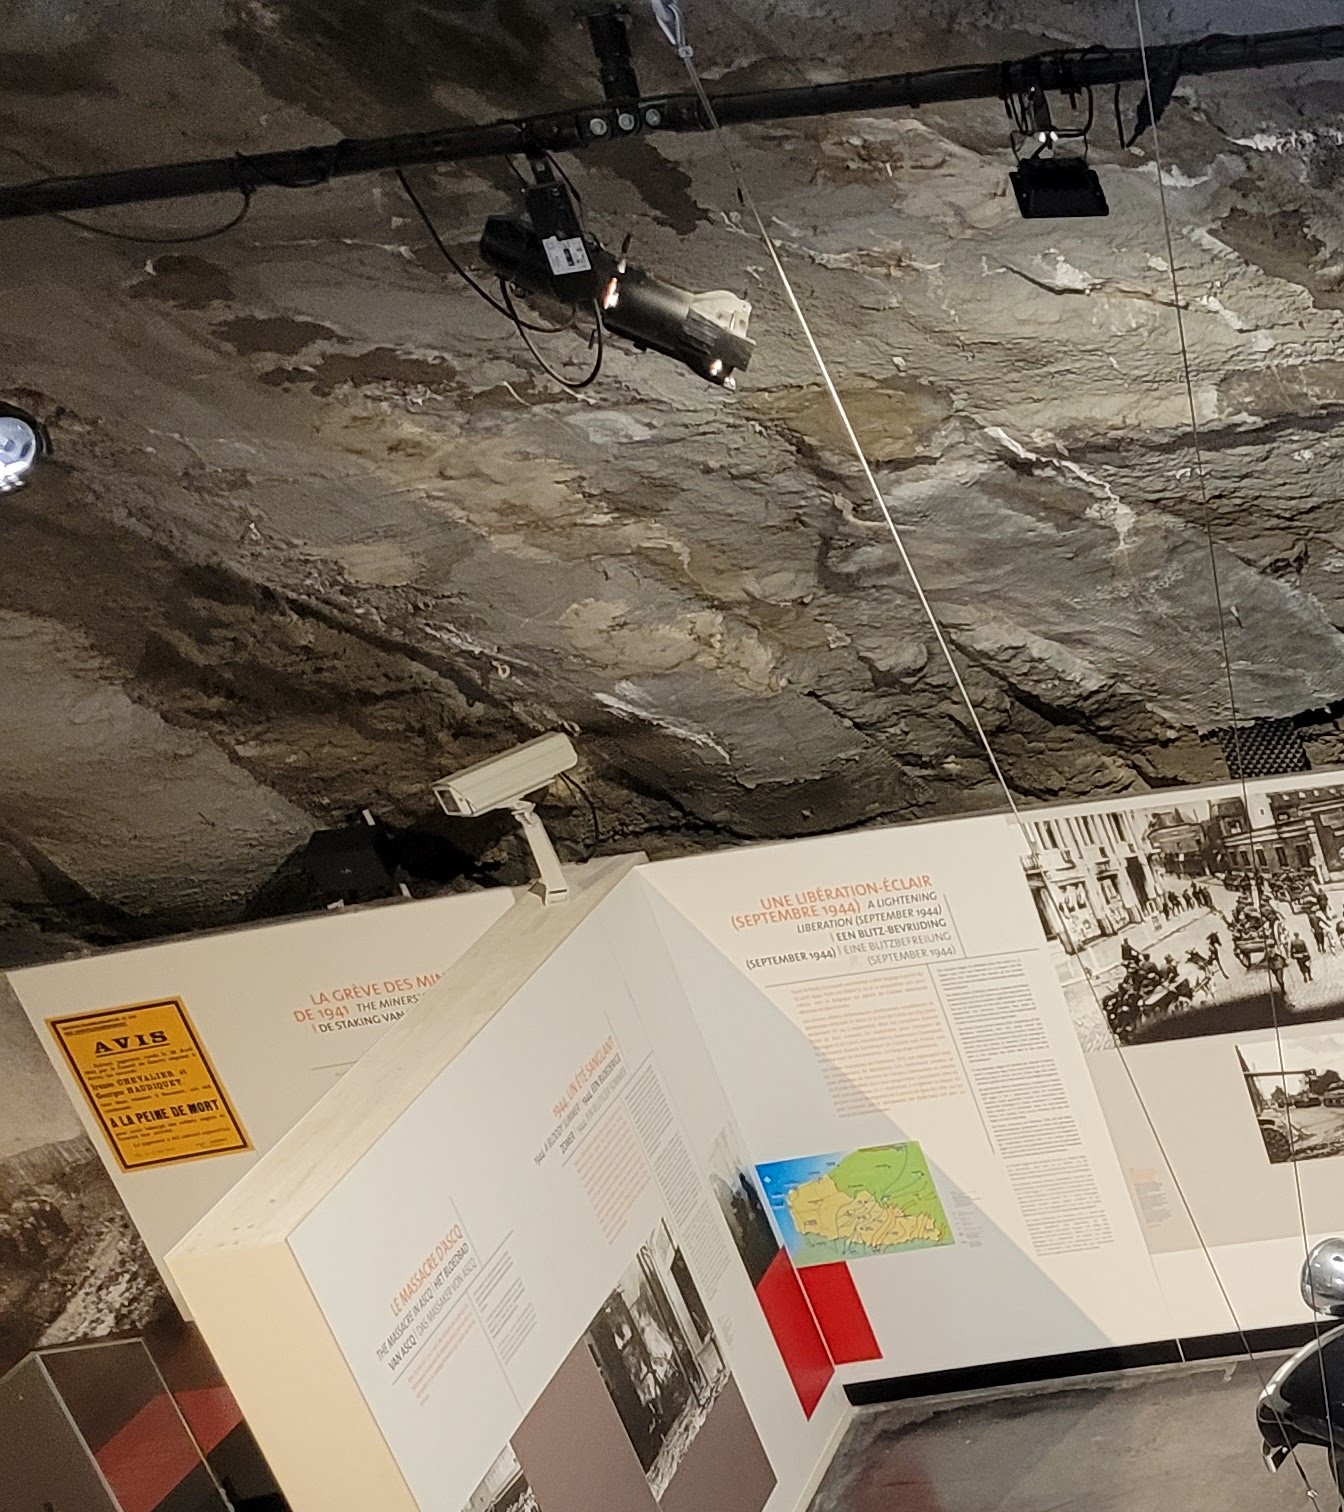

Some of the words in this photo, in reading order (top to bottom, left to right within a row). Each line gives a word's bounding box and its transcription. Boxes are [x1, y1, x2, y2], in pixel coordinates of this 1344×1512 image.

[760, 894, 793, 910] UNE
[795, 875, 933, 905] LIBÉRATION-ÉCLAIR
[868, 900, 875, 909] A
[877, 891, 937, 908] LIGHTENING
[731, 905, 819, 932] (SEPTEMBRE
[822, 898, 861, 918] 1944)
[797, 918, 853, 933] LIBERATION
[855, 909, 914, 926] (SEPTEMBER
[915, 904, 942, 918] 1944)
[746, 952, 808, 970] (SEPTEMBER
[809, 947, 836, 961] 1944)
[843, 942, 867, 955] EINE
[869, 931, 951, 951] BLITZBEFREIUNG
[836, 930, 856, 942] EEN
[867, 949, 928, 967] (SEPTEMBER
[929, 944, 956, 959] 1944)
[309, 992, 329, 1006] LA
[333, 984, 381, 1002] GRÈVE
[384, 978, 413, 994] DES
[416, 972, 445, 989] MIN
[293, 1009, 314, 1023] DE
[318, 1005, 350, 1021] 1941
[357, 1002, 377, 1013] THE
[319, 1023, 334, 1033] DE
[336, 1015, 381, 1031] STAKING
[381, 1011, 405, 1023] VAN
[94, 1030, 168, 1054] AVIS
[110, 1118, 118, 1128] A
[121, 1115, 135, 1126] LA
[137, 1109, 170, 1124] PEINE
[172, 1104, 187, 1117] DE
[189, 1099, 220, 1115] MORT
[390, 1297, 403, 1316] LE
[399, 1253, 438, 1304] MASSACRE
[376, 1343, 389, 1360] THE
[387, 1311, 414, 1346] MASSACRE
[433, 1272, 446, 1289] HET
[388, 1351, 403, 1370] VAN
[399, 1334, 417, 1357] ASCQ
